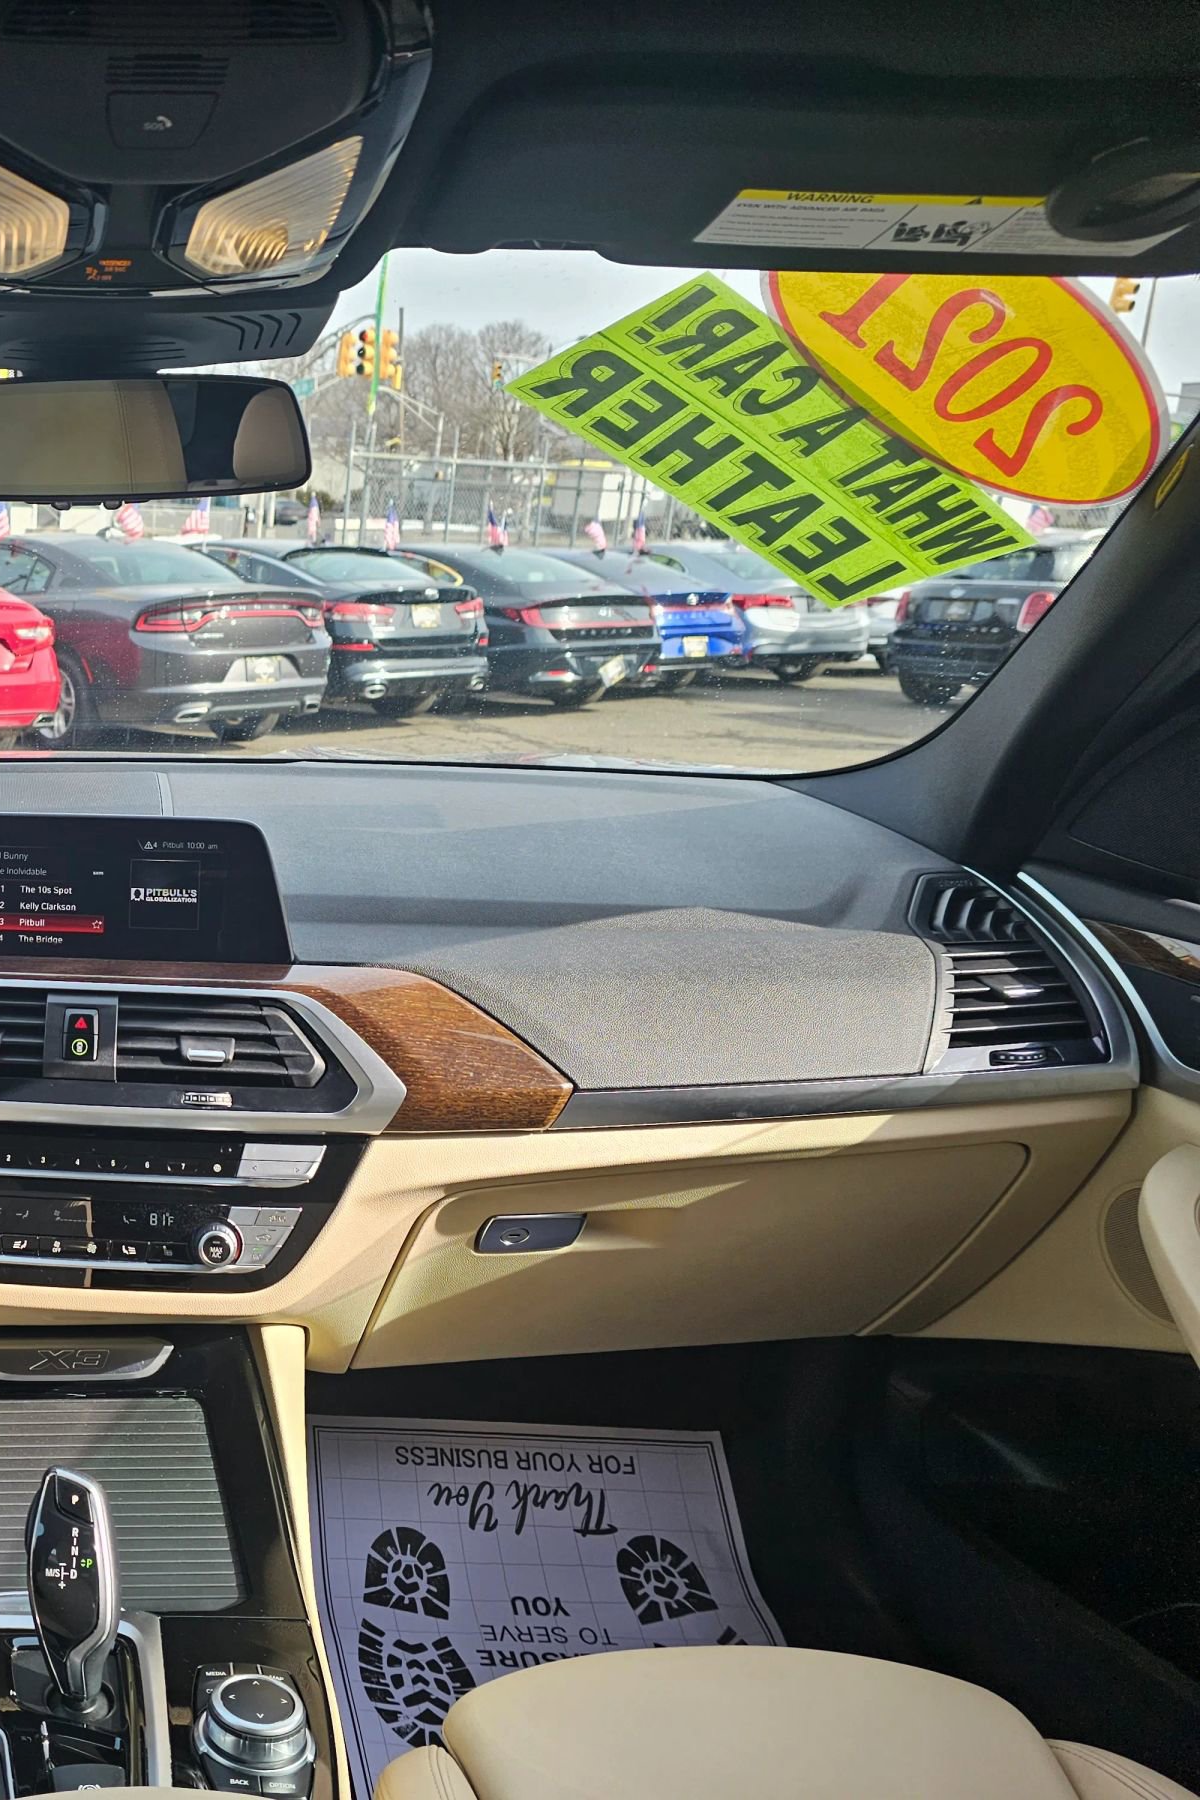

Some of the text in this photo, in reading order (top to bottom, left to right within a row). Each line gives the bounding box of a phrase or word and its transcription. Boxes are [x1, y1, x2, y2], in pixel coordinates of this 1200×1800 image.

[786, 191, 875, 204] WARNING
[3, 852, 29, 862] Bunny
[6, 867, 48, 876] Inolvidable
[20, 885, 36, 894] The
[38, 886, 52, 895] 10s
[53, 886, 73, 896] Spot
[146, 888, 198, 898] PITBULL'S
[19, 902, 40, 912] Kelly
[40, 902, 77, 912] Clarkson
[19, 918, 46, 927] Pitbull
[18, 934, 35, 943] The
[36, 935, 64, 944] Bridge
[6, 1154, 12, 1162] 2
[40, 1156, 46, 1164] 3
[74, 1158, 81, 1166] 4
[180, 1162, 186, 1170] 7
[209, 1245, 223, 1254] MAX
[28, 1349, 110, 1370] X3
[394, 1445, 636, 1476] FOR YOUR BUSINESS
[71, 1494, 80, 1505] P
[426, 1479, 619, 1538] Thank You
[71, 1527, 80, 1538] R
[70, 1545, 80, 1556] N
[45, 1567, 78, 1580] M/S D
[510, 1595, 571, 1617] YOU
[479, 1624, 619, 1647] TO SERVE
[475, 1649, 572, 1669] SURE
[229, 1778, 250, 1786] BACK
[268, 1781, 297, 1790] OPTION
